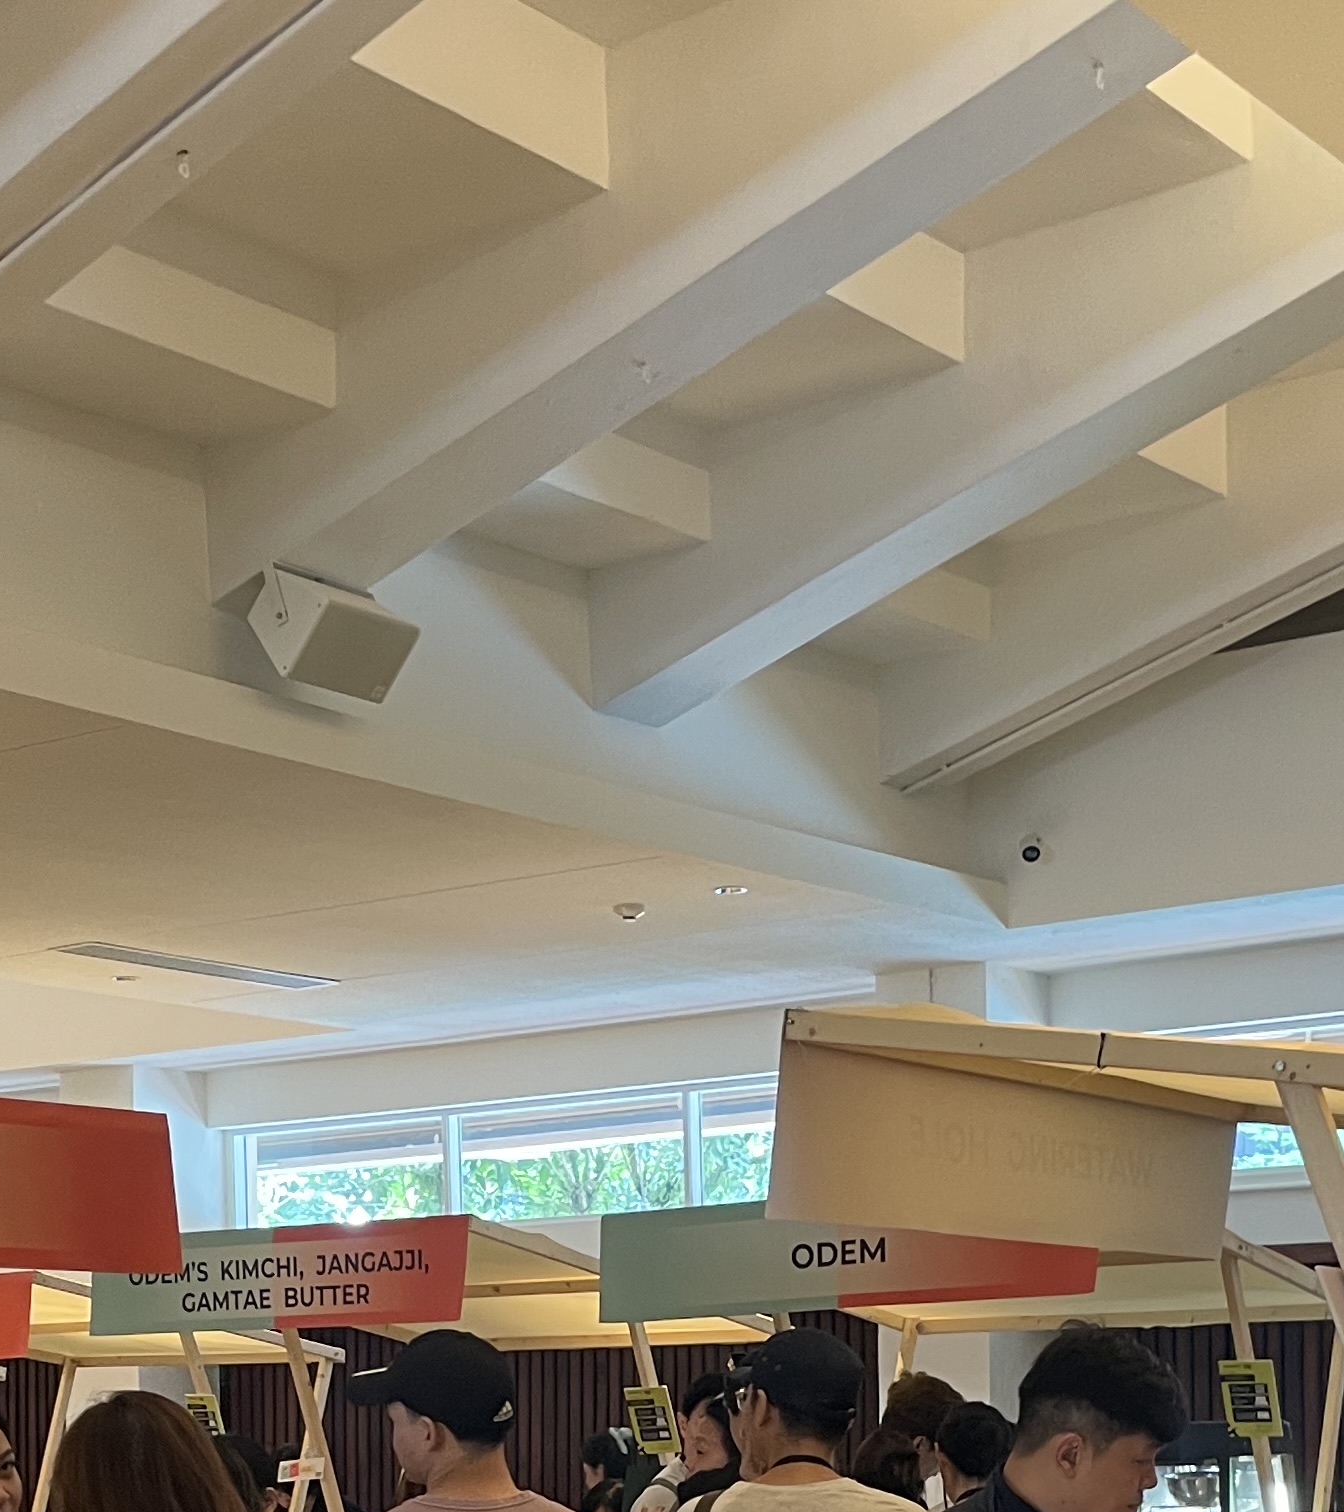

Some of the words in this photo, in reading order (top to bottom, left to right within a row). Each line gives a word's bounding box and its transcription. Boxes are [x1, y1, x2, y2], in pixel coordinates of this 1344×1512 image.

[220, 1256, 304, 1281] KIMCHI,
[316, 1249, 429, 1275] JANGAJJI,
[791, 1236, 886, 1269] ODEM
[182, 1289, 271, 1313] GAMTAE
[284, 1283, 370, 1308] BUTTER
